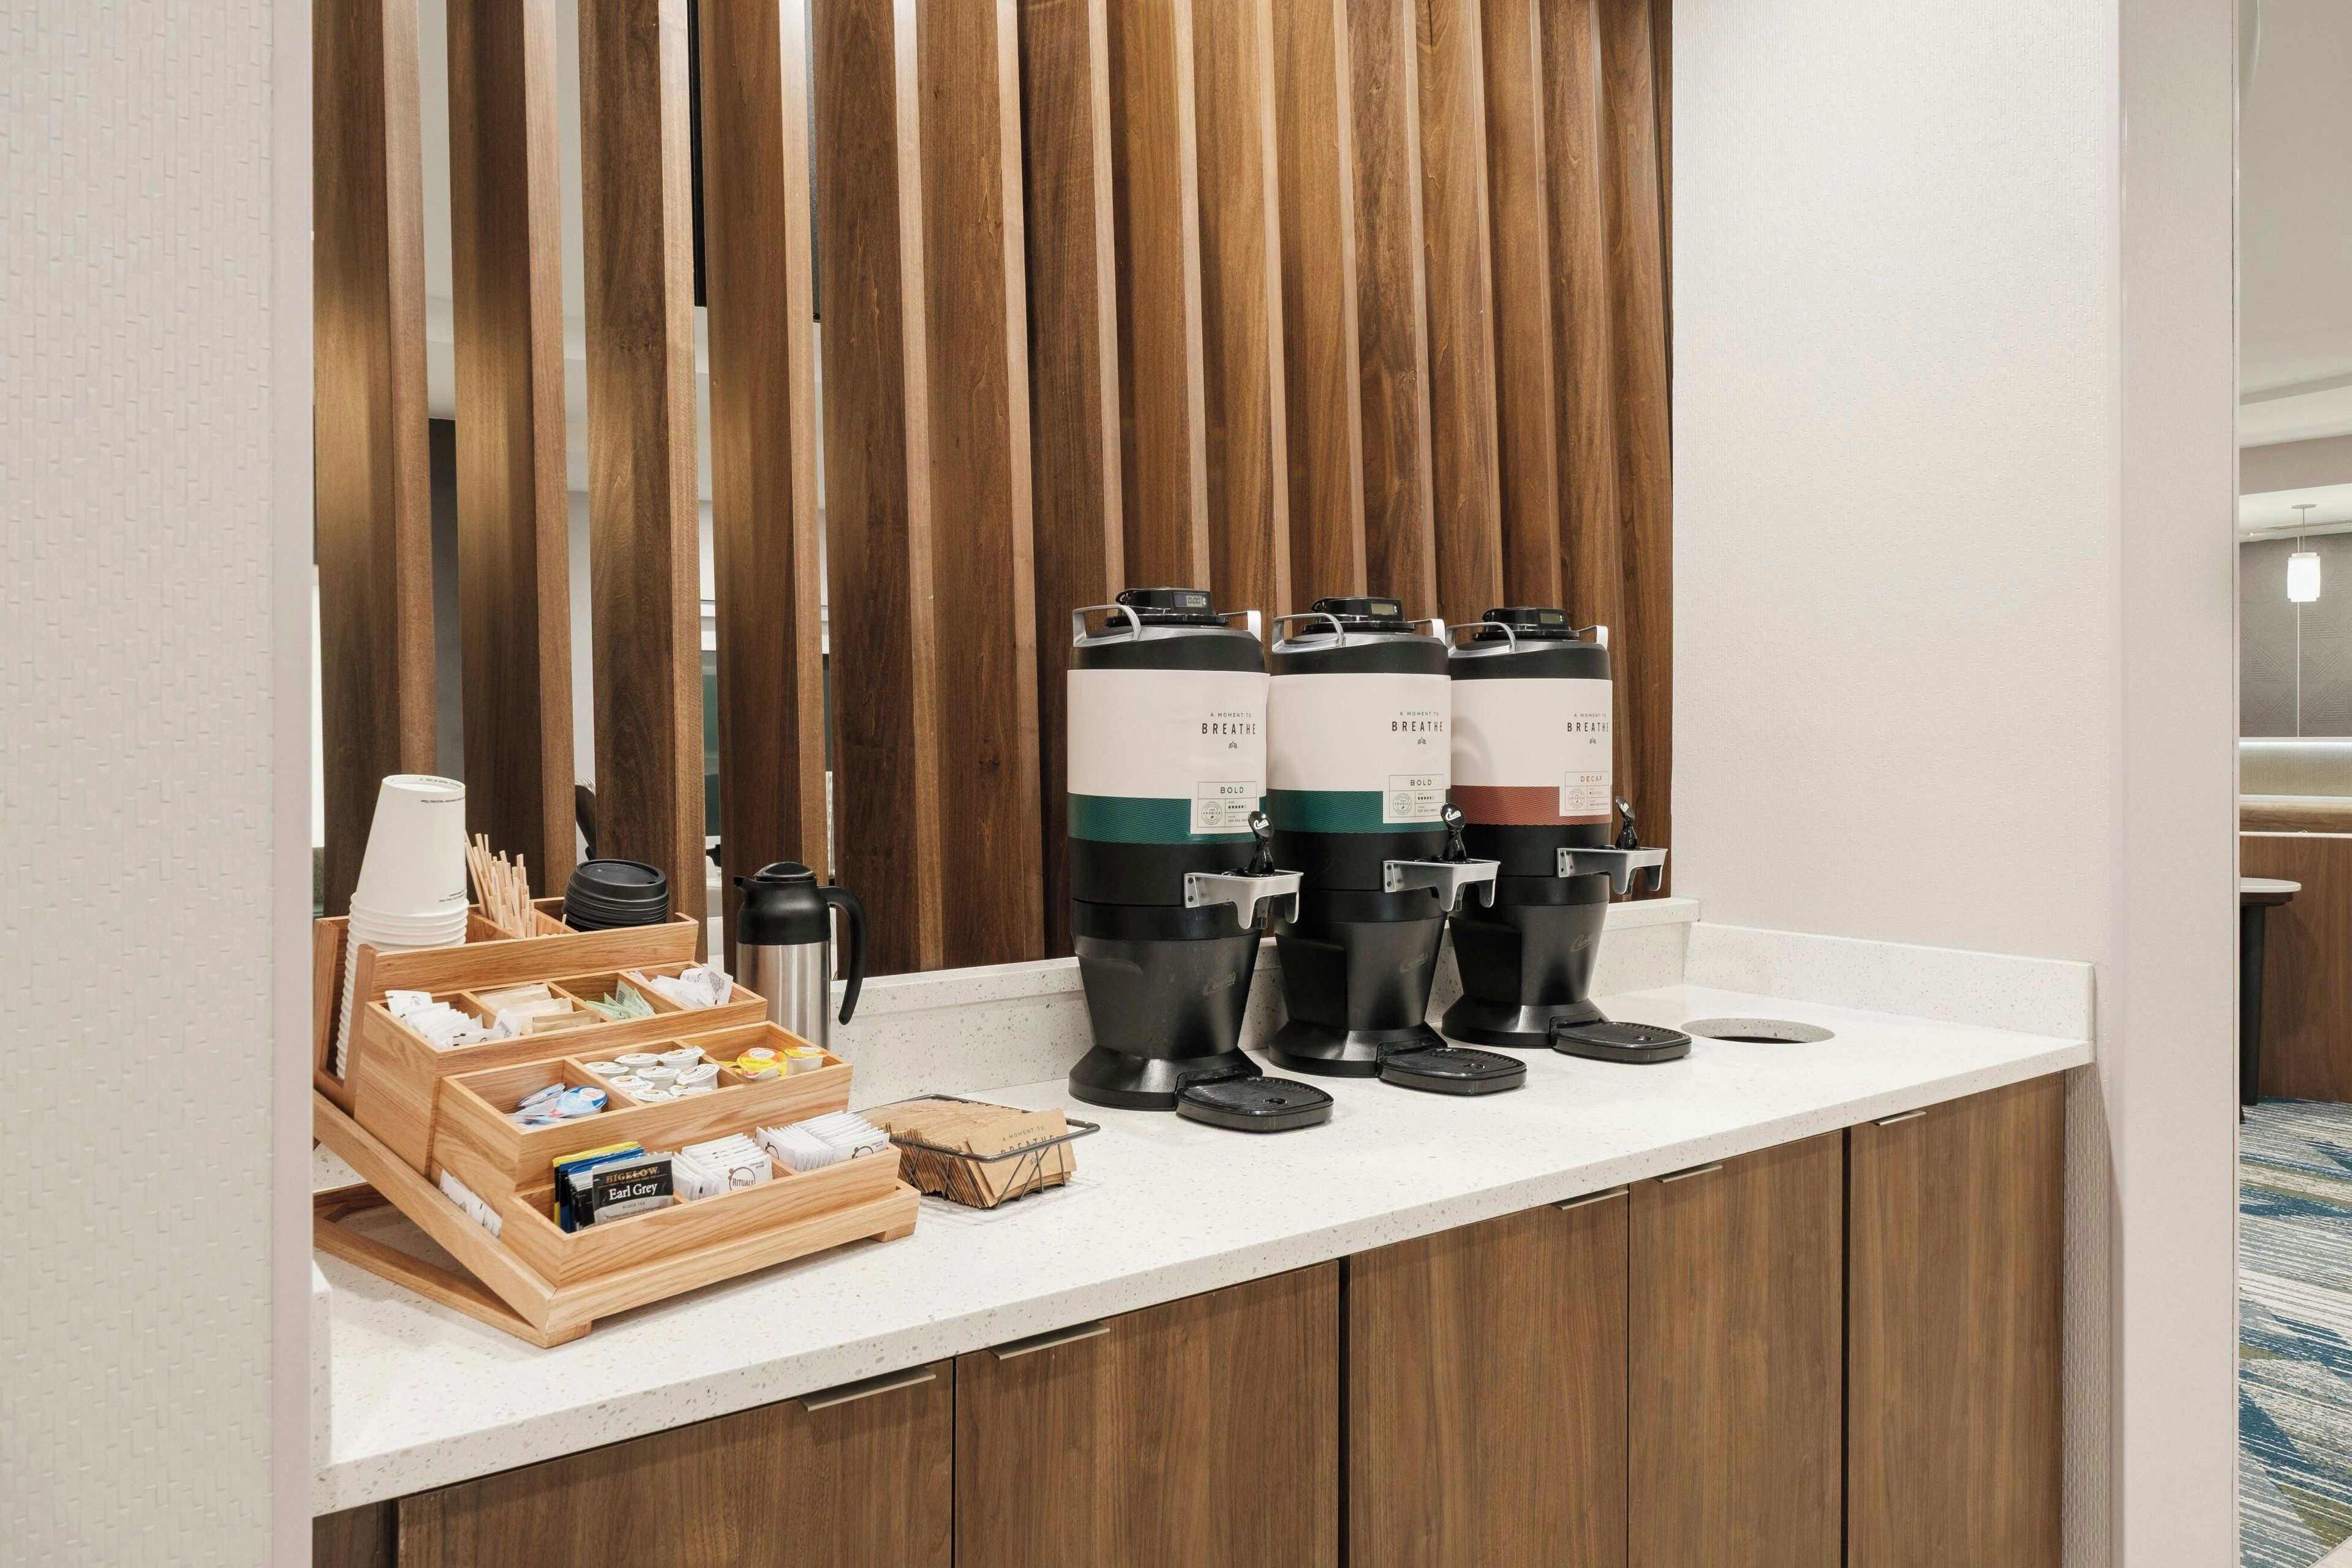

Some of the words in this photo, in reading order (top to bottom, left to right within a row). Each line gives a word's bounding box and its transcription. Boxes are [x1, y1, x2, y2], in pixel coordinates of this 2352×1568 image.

[1202, 723, 1256, 735] BREATHE
[1392, 721, 1442, 732] BREATHE
[1567, 722, 1608, 732] BREATHE
[1009, 1128, 1034, 1139] MOMENT
[606, 1166, 660, 1183] BIGELOW
[732, 1178, 754, 1186] RITUALS
[609, 1185, 631, 1200] Earl
[632, 1183, 658, 1196] Grey
